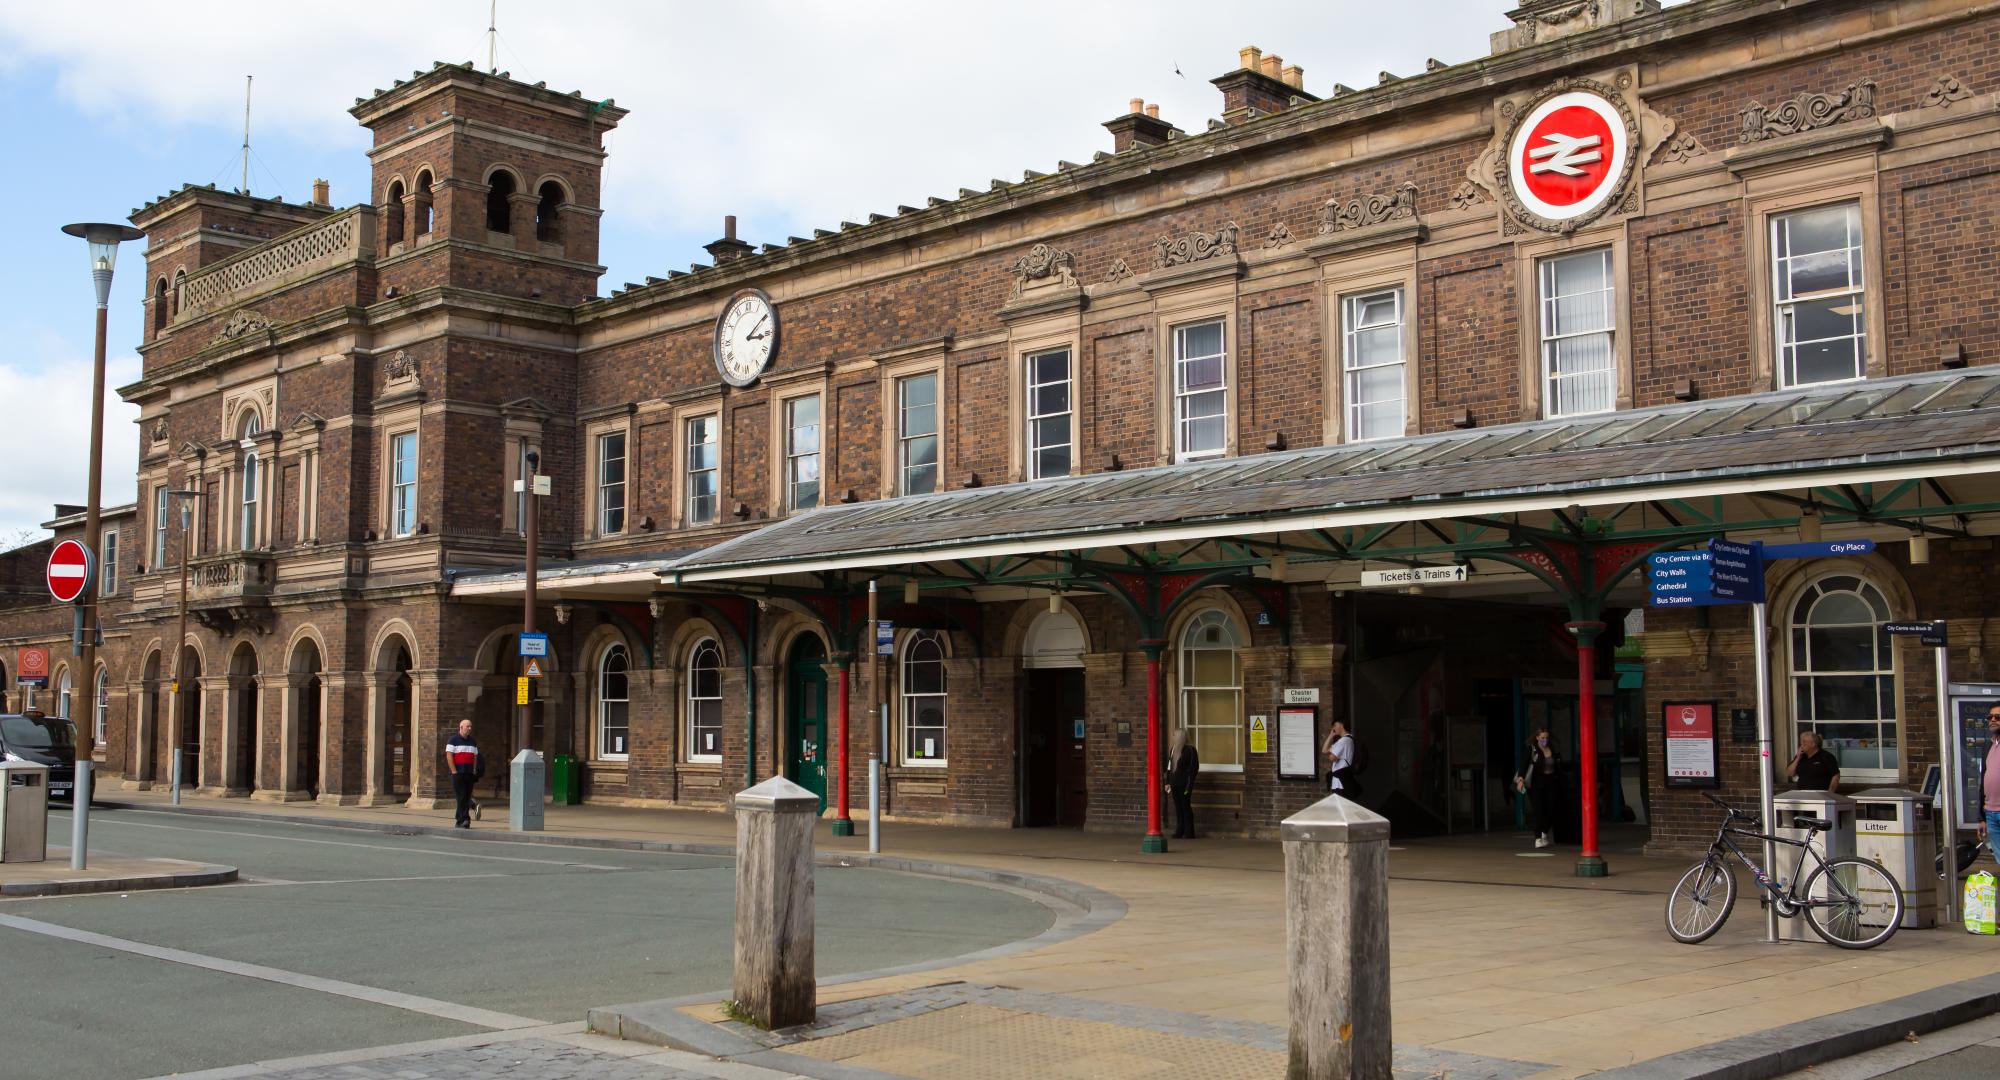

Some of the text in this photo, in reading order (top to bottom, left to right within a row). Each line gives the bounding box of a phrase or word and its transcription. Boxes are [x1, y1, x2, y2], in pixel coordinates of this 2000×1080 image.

[1830, 543, 1866, 553] City Place
[1655, 556, 1668, 564] City
[1669, 555, 1691, 563] Centre
[1691, 553, 1701, 561] via
[1380, 569, 1451, 582] Tickets & Trains
[1655, 568, 1687, 578] City Walls
[1656, 582, 1687, 590] Cathedral
[1669, 595, 1693, 603] Station
[1865, 822, 1888, 831] Litter
